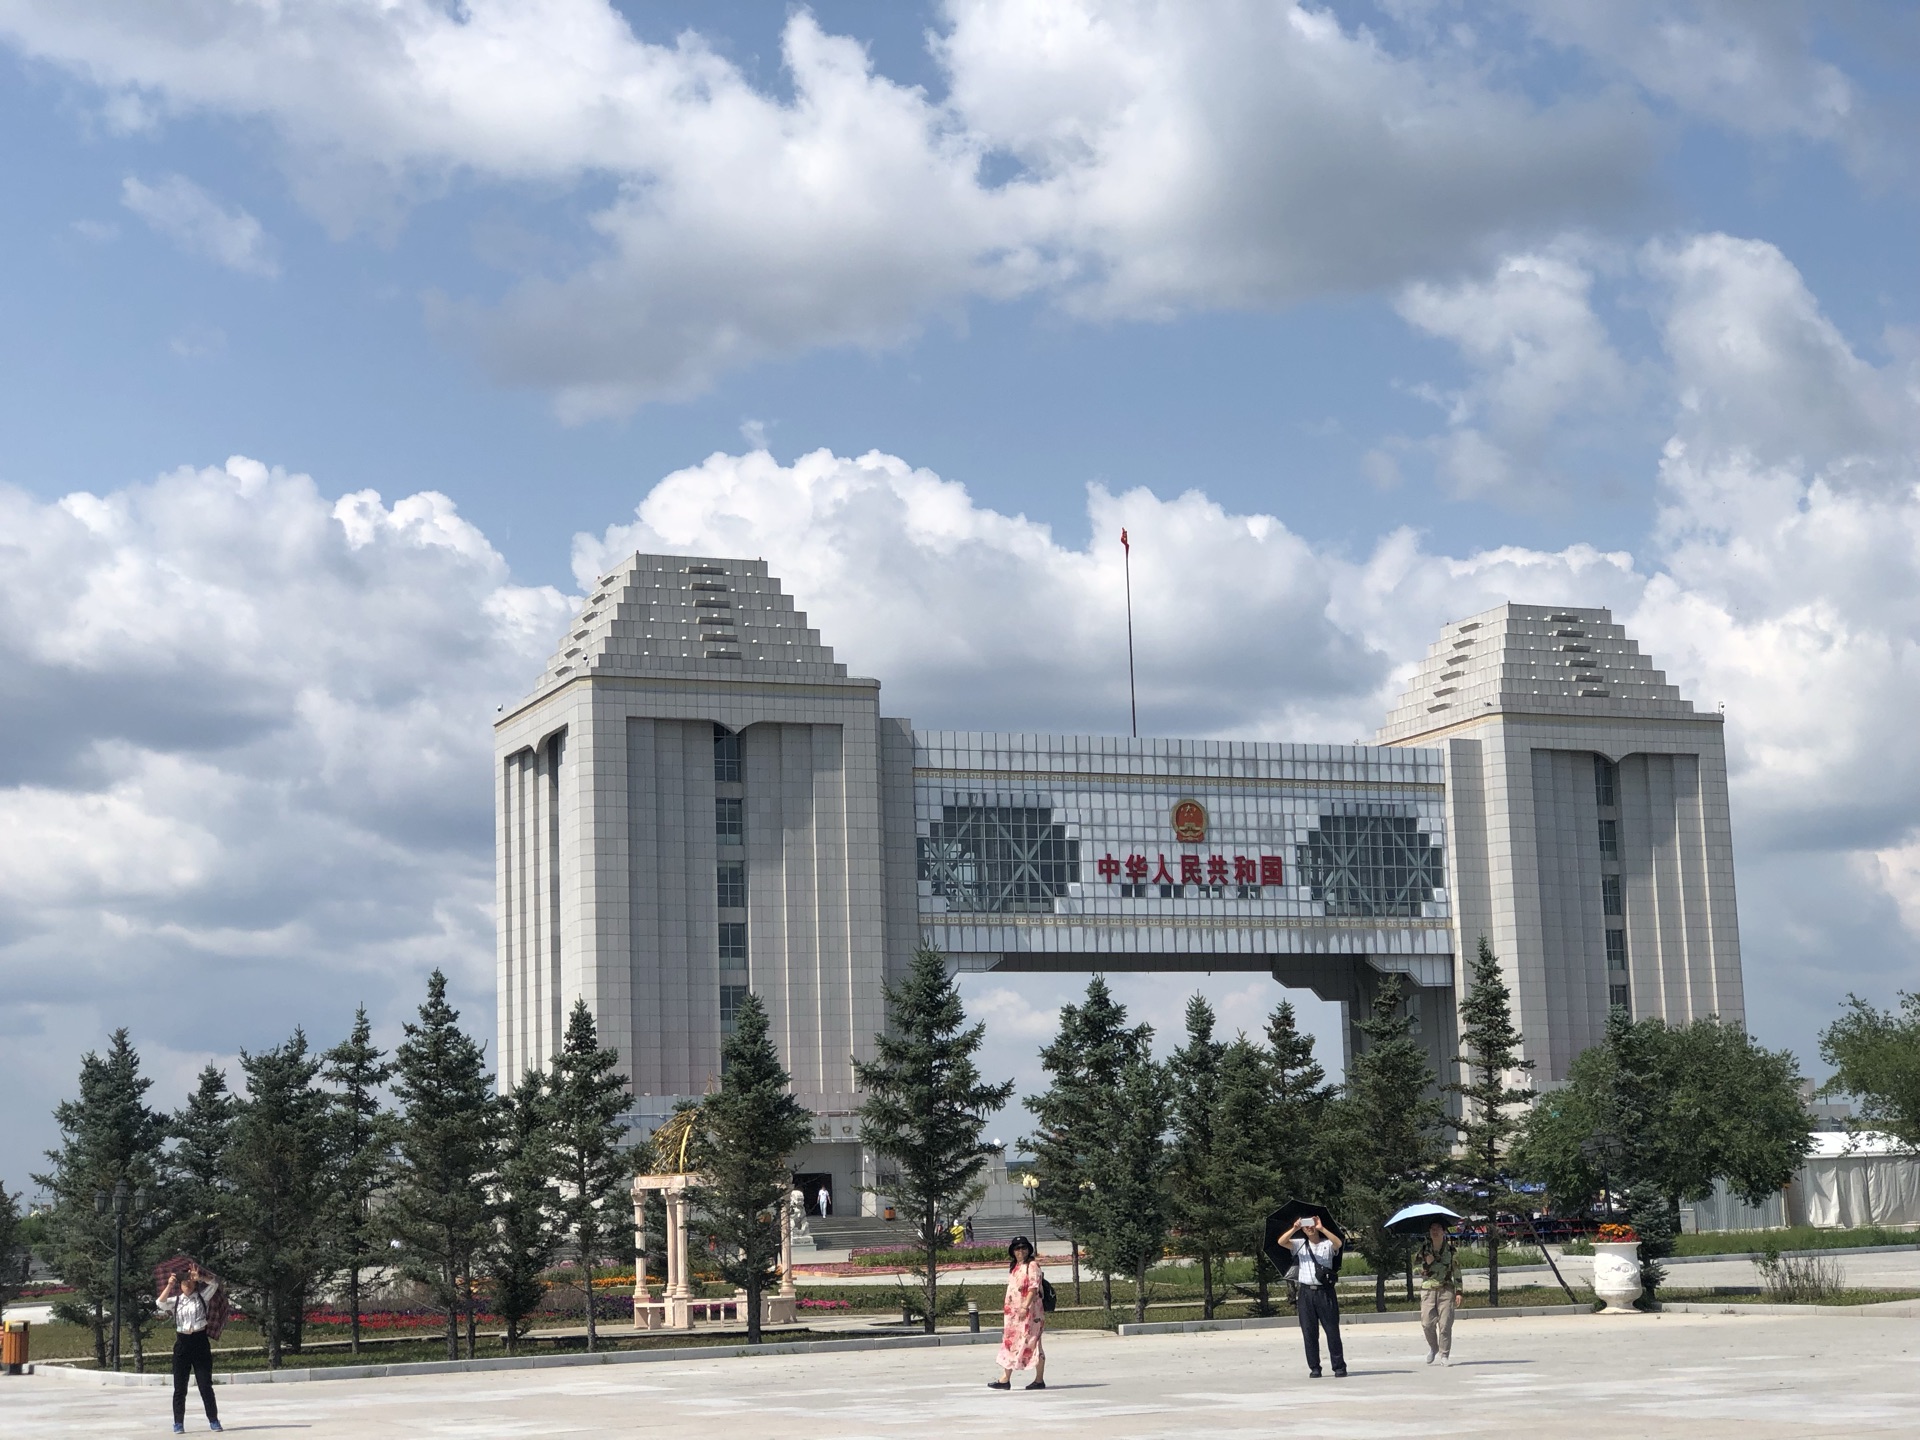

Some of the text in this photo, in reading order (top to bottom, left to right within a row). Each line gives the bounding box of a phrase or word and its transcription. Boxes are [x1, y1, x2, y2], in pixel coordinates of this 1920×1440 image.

[1098, 853, 1283, 886] 中华人民共和国
